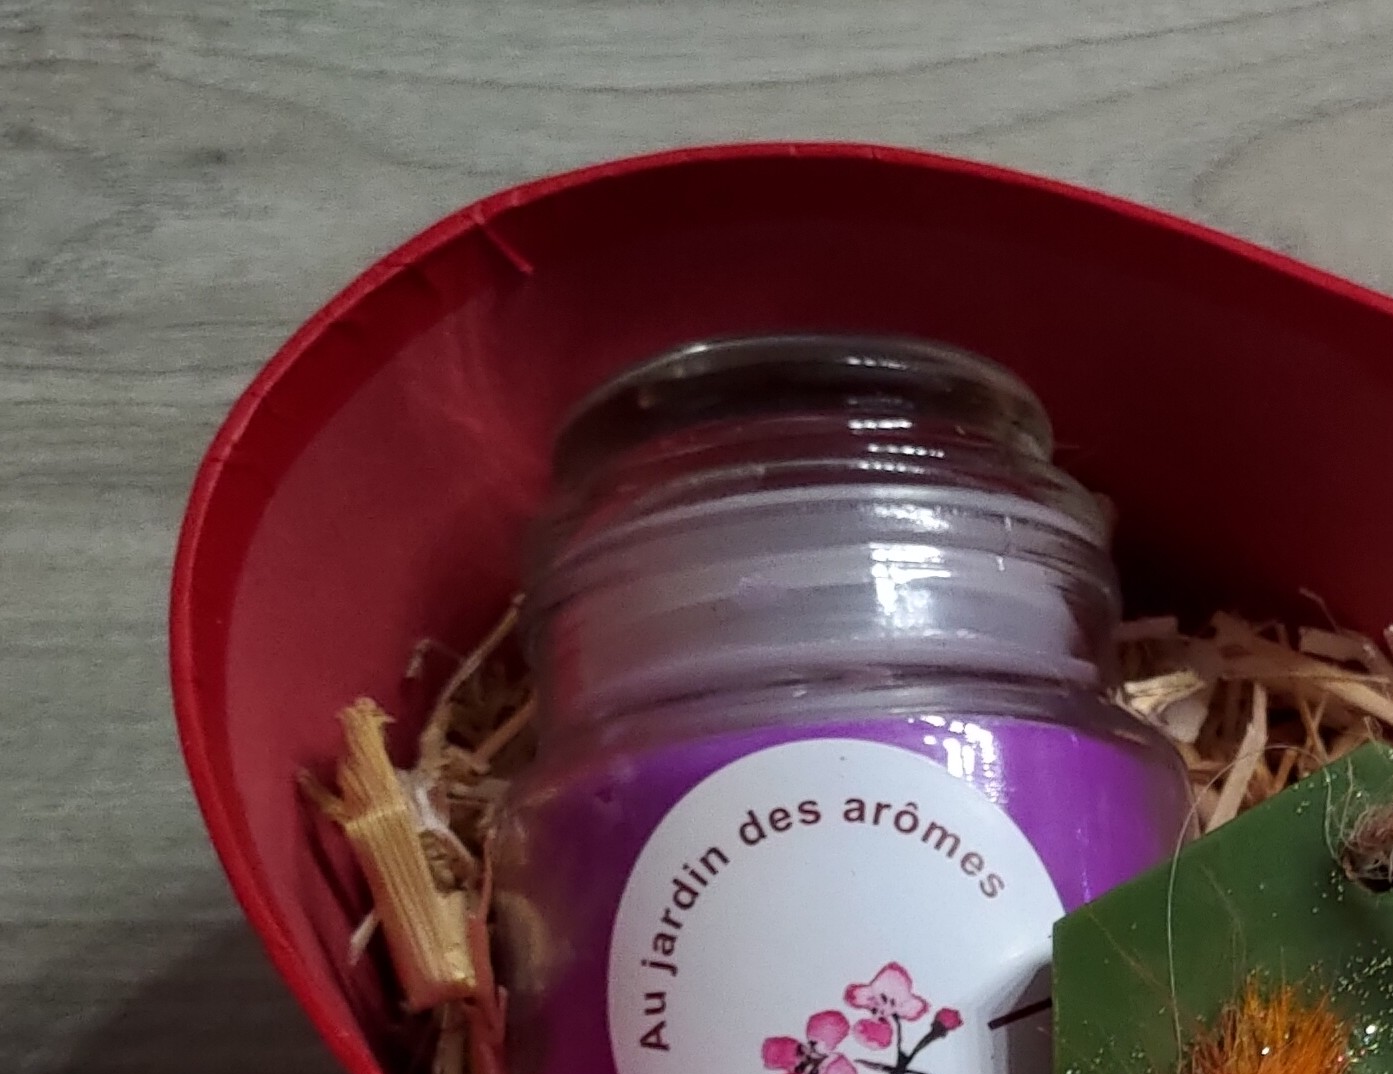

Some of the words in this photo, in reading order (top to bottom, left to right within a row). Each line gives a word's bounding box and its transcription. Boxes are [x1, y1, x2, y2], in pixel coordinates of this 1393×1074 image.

[738, 798, 822, 846] des
[843, 797, 1006, 900] arômes
[640, 846, 730, 977] jardin
[639, 991, 671, 1053] Au
